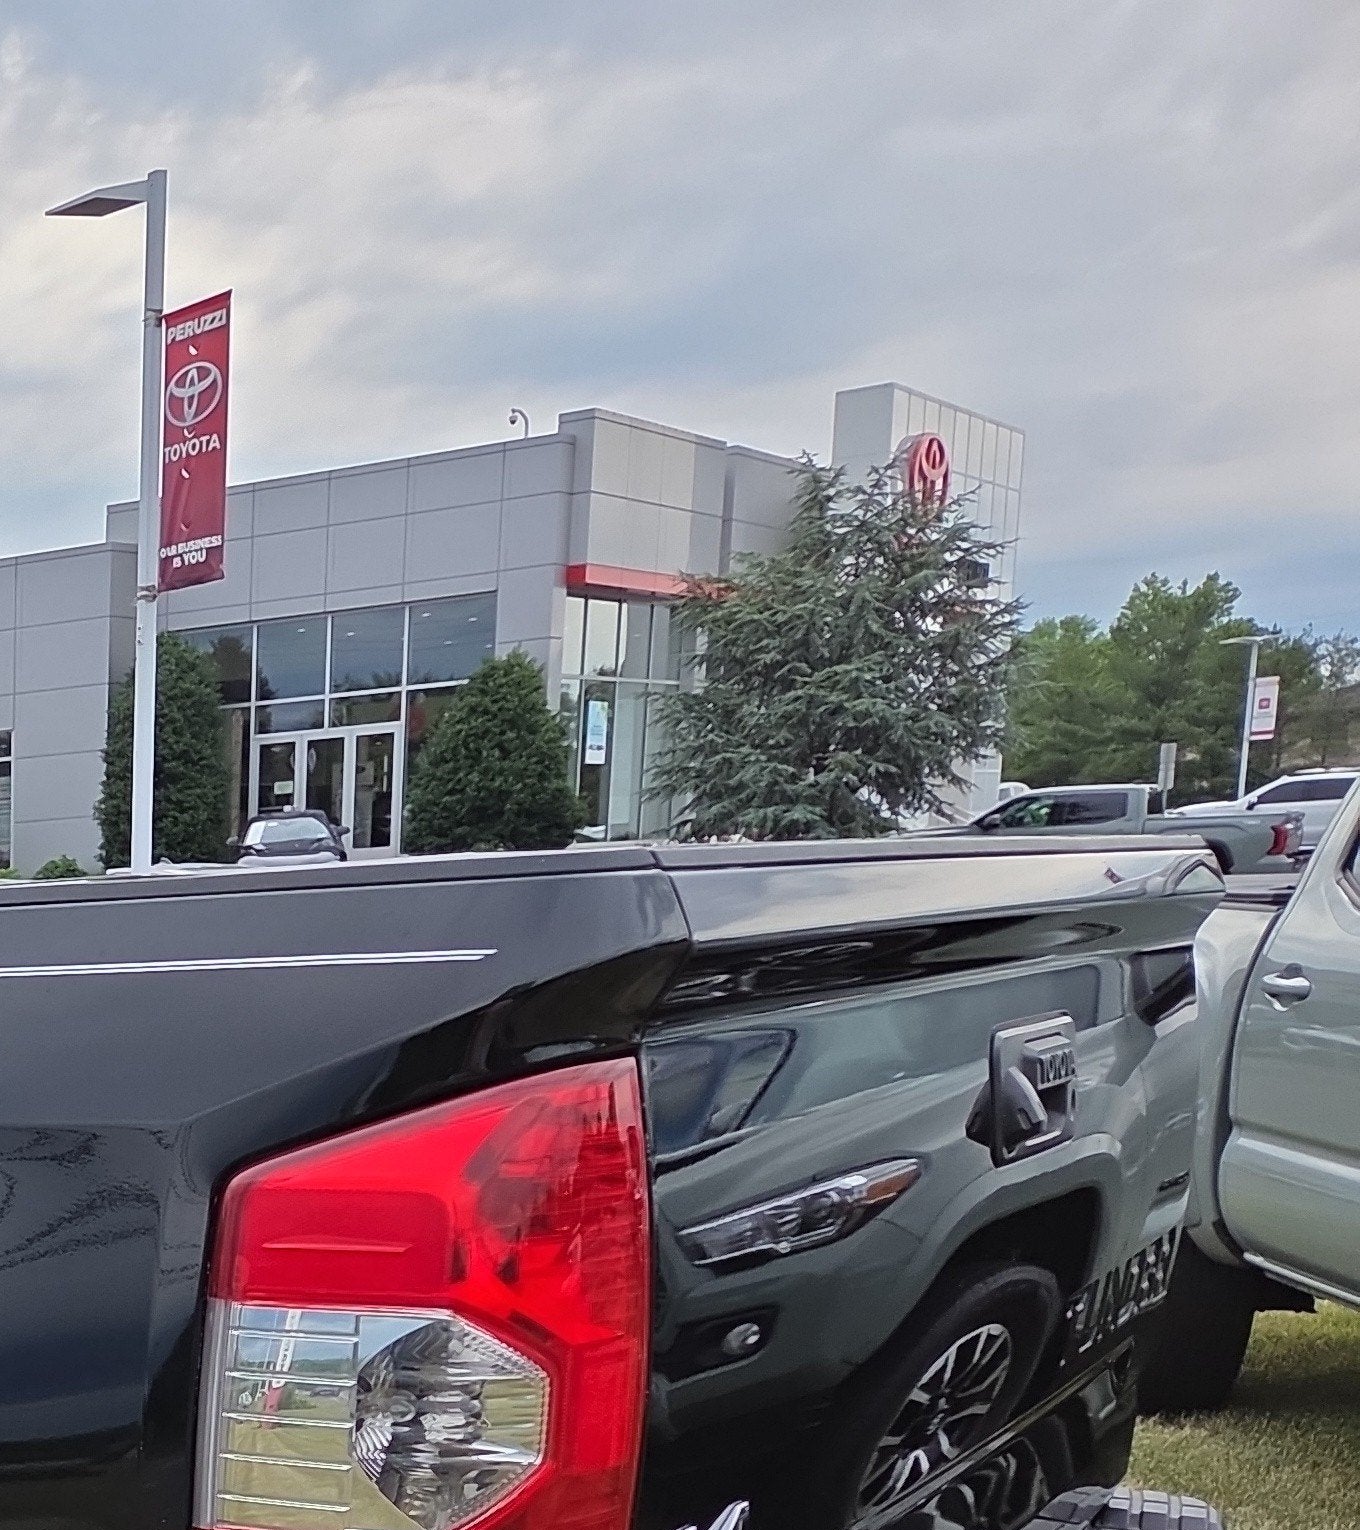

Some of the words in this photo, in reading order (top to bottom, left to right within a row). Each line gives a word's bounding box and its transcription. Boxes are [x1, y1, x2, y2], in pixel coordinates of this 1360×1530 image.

[166, 308, 227, 345] PERUZZI
[164, 433, 221, 463] TOYOTA
[182, 549, 207, 566] YOU
